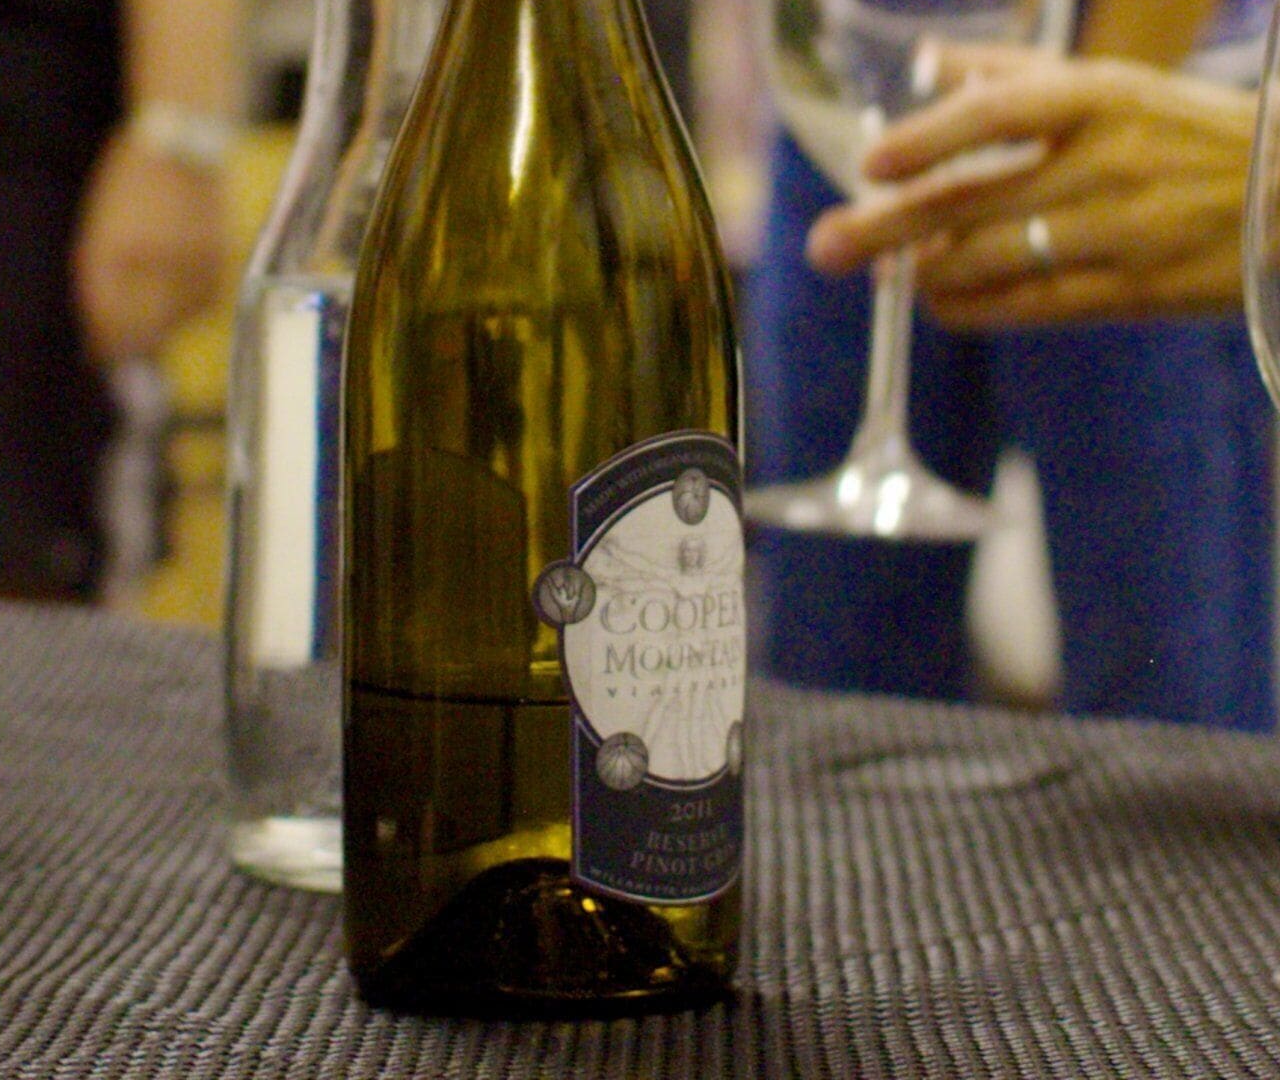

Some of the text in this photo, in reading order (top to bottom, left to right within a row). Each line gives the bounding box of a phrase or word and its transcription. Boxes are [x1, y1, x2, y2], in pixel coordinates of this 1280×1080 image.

[603, 637, 740, 681] MOUNTA
[669, 798, 715, 823] 2011
[629, 850, 699, 876] PINOT
